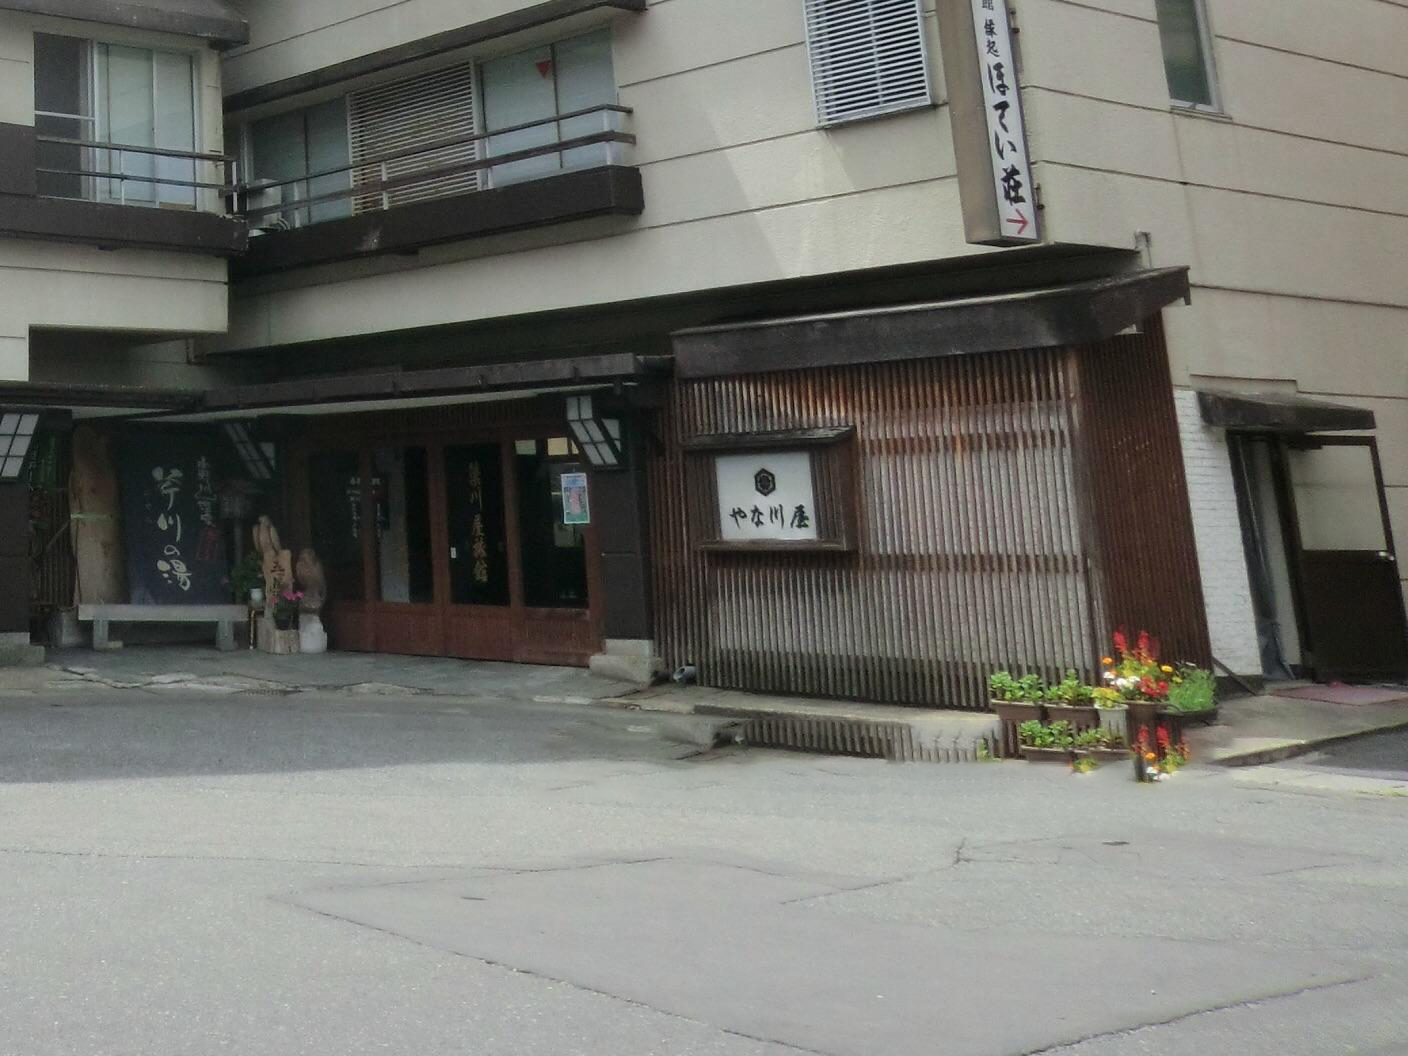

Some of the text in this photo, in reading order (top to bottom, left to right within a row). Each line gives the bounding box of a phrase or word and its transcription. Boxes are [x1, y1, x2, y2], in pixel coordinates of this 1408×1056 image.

[988, 62, 1027, 206] ほてい荘
[728, 503, 810, 530] やな川屋
